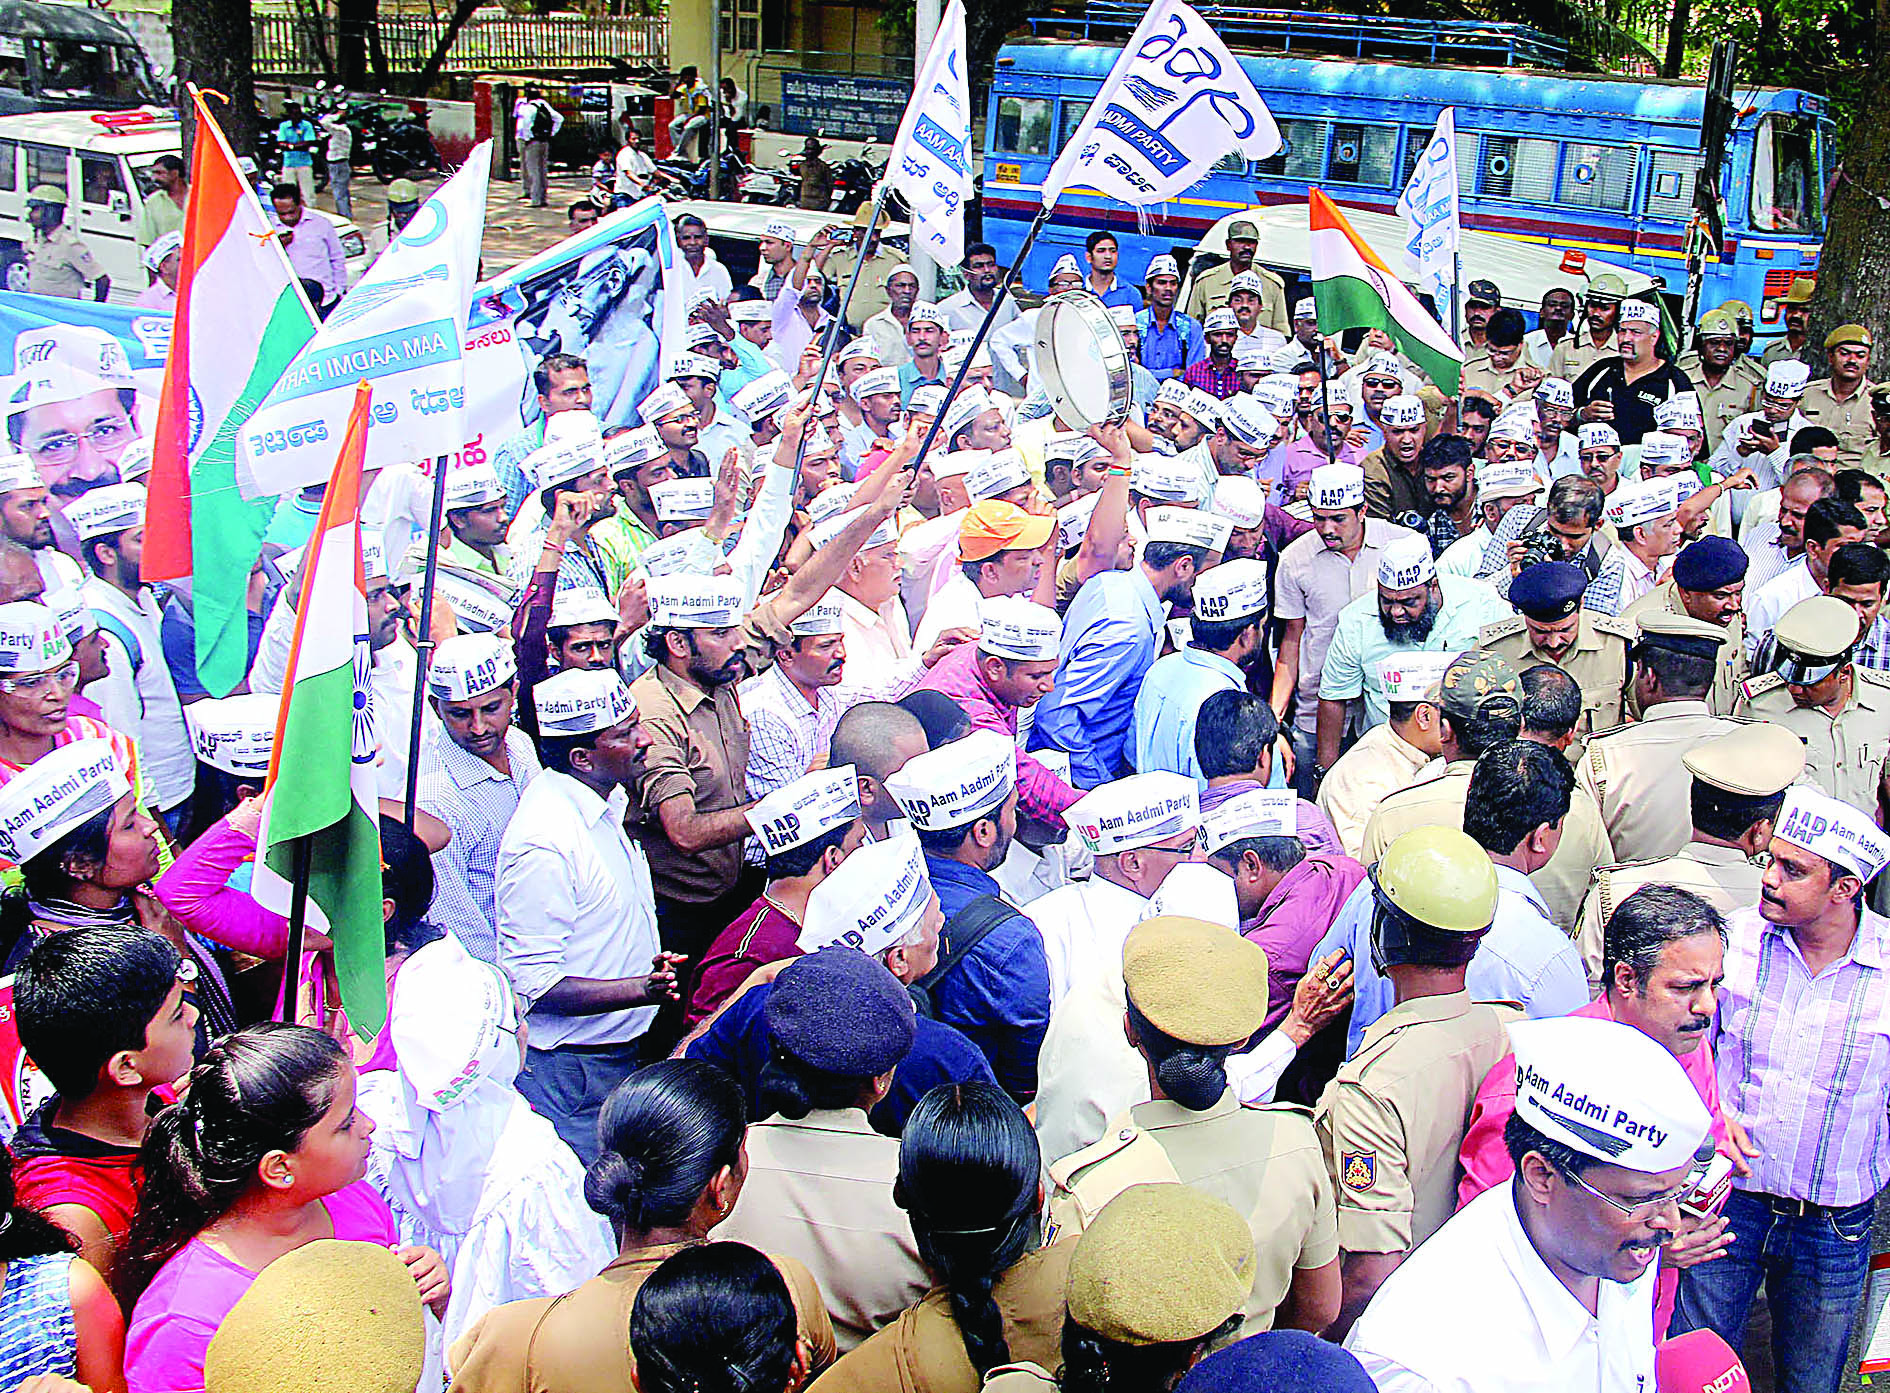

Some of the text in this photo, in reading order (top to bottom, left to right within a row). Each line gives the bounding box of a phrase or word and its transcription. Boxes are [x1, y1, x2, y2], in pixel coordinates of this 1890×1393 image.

[915, 121, 949, 150] AAM
[1130, 129, 1179, 166] PARTY
[1627, 306, 1646, 319] AAP
[1591, 430, 1609, 446] AAP
[1320, 487, 1345, 506] AAP
[1678, 480, 1697, 490] Party
[362, 546, 381, 559] arty
[1397, 564, 1421, 588] AAP
[459, 598, 488, 621] Aadmi
[660, 595, 679, 607] Aam
[682, 595, 714, 607] Aadmi
[717, 595, 741, 609] Party
[817, 605, 842, 618] Party
[1200, 595, 1229, 618] AAP
[0, 631, 35, 650] Party
[464, 658, 498, 695] AAP
[543, 696, 608, 714] Aadmi Party
[4, 754, 115, 836] Aam Aadmi Party
[930, 769, 996, 808] Aam Aadmi
[1099, 815, 1124, 832] Aam
[1127, 802, 1164, 825] Aadmi
[1166, 794, 1191, 816] Party
[762, 812, 801, 850] AAP
[1782, 806, 1828, 845] AAP
[1830, 819, 1856, 842] Aam
[857, 904, 888, 933] Aam
[883, 868, 914, 908] Aadmi
[1524, 1064, 1550, 1095] Aam
[1551, 1082, 1610, 1124] Aadmi
[1613, 1110, 1669, 1149] Party
[1702, 1363, 1746, 1393] NDTV
